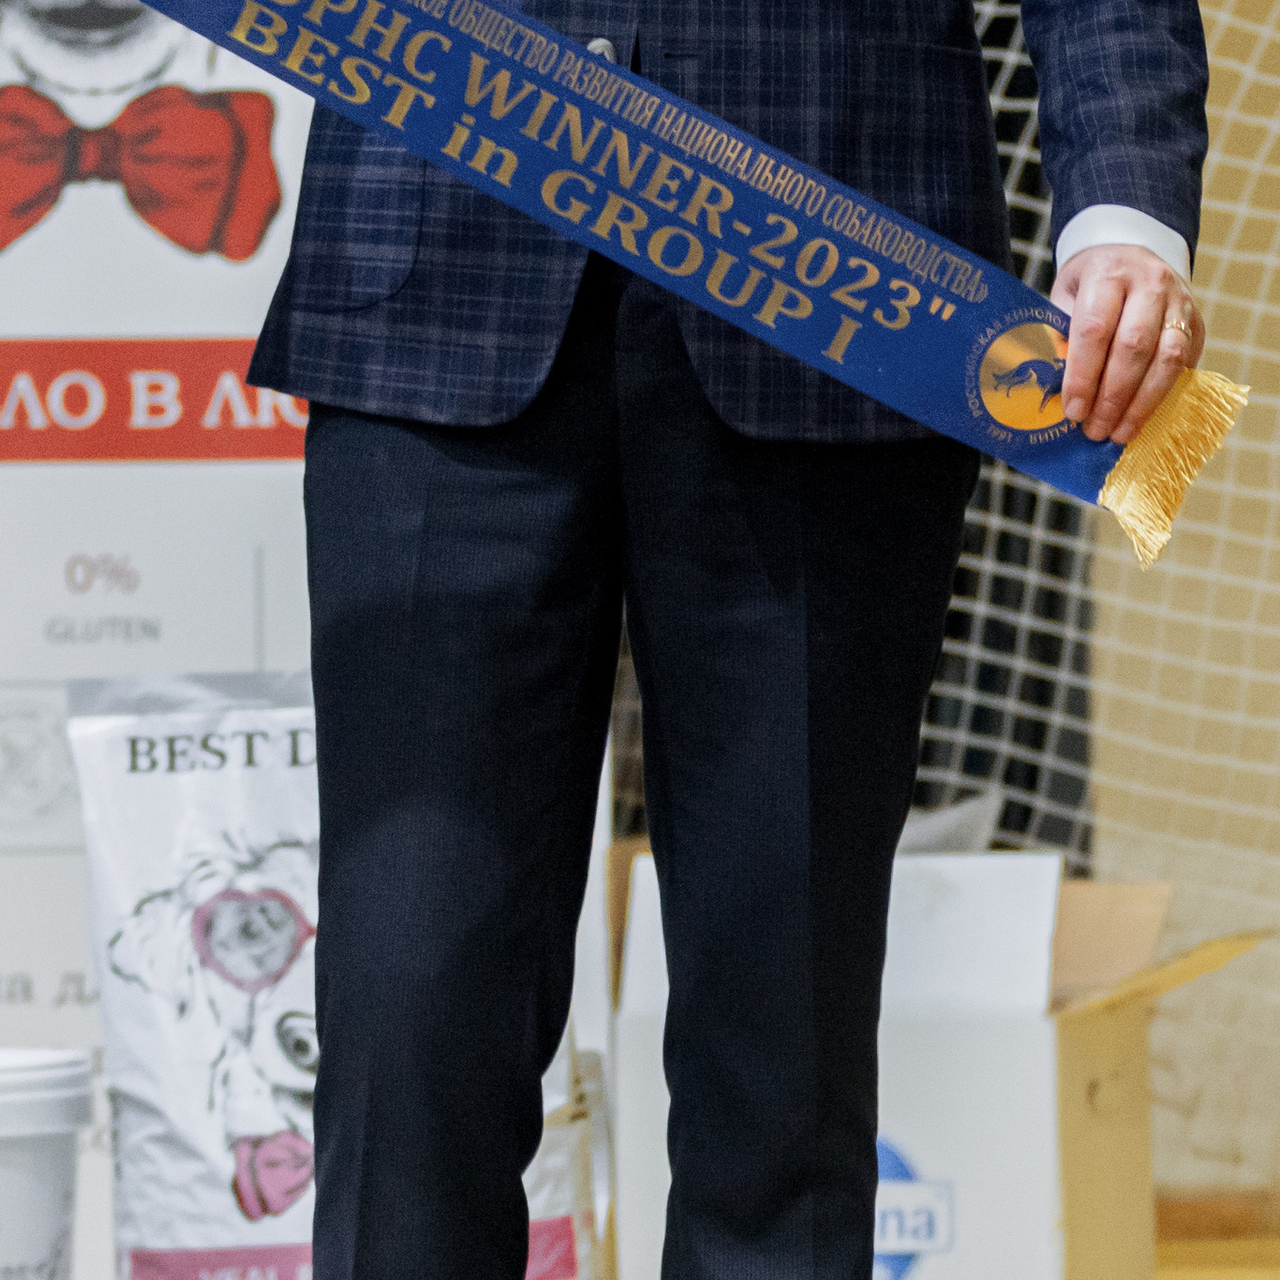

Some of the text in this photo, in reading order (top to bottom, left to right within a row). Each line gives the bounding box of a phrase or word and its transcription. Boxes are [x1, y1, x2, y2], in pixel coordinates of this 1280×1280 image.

[440, 112, 519, 189] in
[541, 169, 814, 329] GROUP
[821, 313, 863, 365] I
[464, 51, 957, 331] WINNER-2023"
[553, 49, 661, 129] РАЗВИТИЯ
[652, 102, 827, 218] НАЦИОНАЛЬНОГО
[821, 193, 989, 303] СОБАКОВОДСТВА»
[127, 729, 270, 773] BEST
